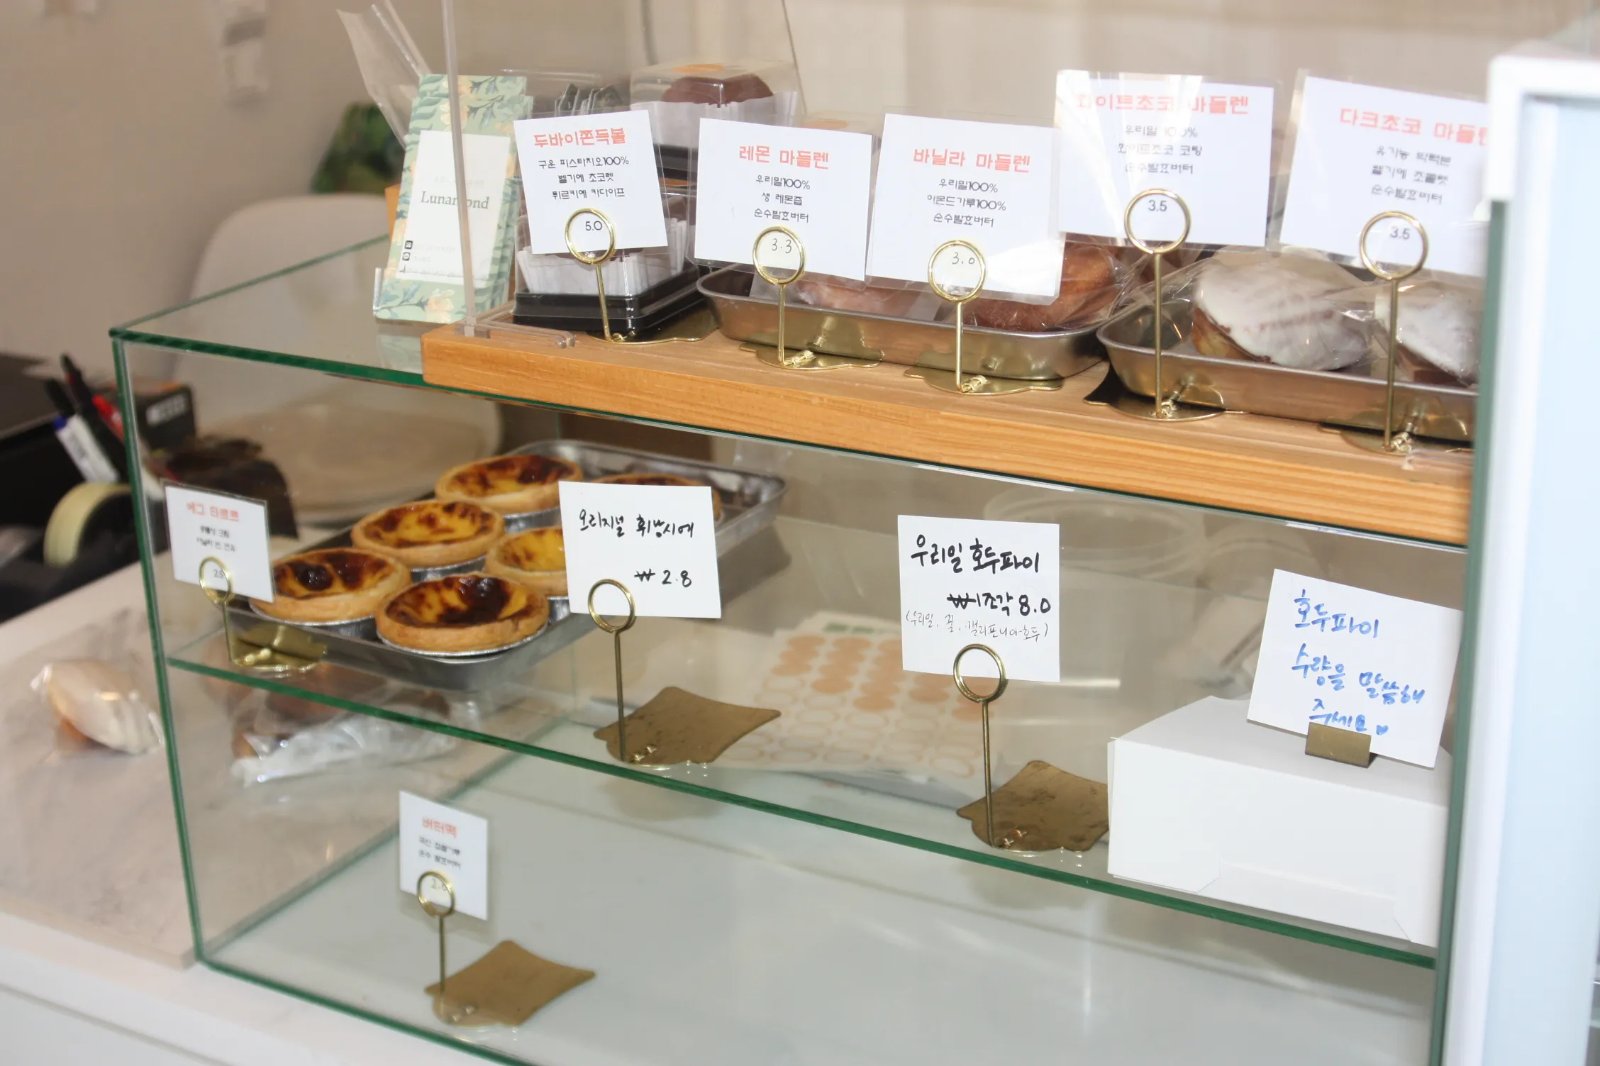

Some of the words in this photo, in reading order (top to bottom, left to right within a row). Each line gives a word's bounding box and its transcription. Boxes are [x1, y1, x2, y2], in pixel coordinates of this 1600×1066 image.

[1339, 108, 1422, 135] 다크초코
[533, 127, 626, 148] 두바이쫀득볼
[739, 145, 771, 163] 레몬
[779, 150, 829, 170] 마들렌
[1179, 145, 1203, 156] 코팅
[1376, 145, 1409, 160] 유기농
[538, 159, 556, 169] 구운
[560, 156, 629, 168] 피스타치오100%
[913, 148, 965, 167] 바닐라
[976, 153, 1031, 173] 마들렌
[558, 173, 585, 184] 벨기에
[589, 172, 614, 183] 초코렛
[756, 174, 810, 190] 우리밀100%
[939, 178, 998, 193] 우리밀100%
[762, 193, 770, 203] 생
[776, 194, 803, 206] 레몬즙
[1371, 184, 1443, 204] 순수발효버터
[927, 194, 1007, 211] 아몬드가루100%
[1148, 200, 1167, 213] 3.5
[754, 208, 809, 223] 순수발효버터
[933, 213, 994, 228] 순수발효버터
[585, 220, 603, 231] 5.0
[1390, 226, 1411, 240] 3.5
[771, 238, 792, 254] 3.3
[952, 251, 975, 265] 3.0
[579, 508, 625, 538] 오리지널
[636, 514, 694, 538] 휘낭시에
[969, 537, 1040, 574] 호두파이
[1018, 594, 1051, 616] 8.0
[1294, 589, 1379, 638] 호두파이
[1292, 643, 1346, 691] 수량을
[1359, 672, 1425, 704] 말씀해
[1309, 698, 1367, 731] 주세요
